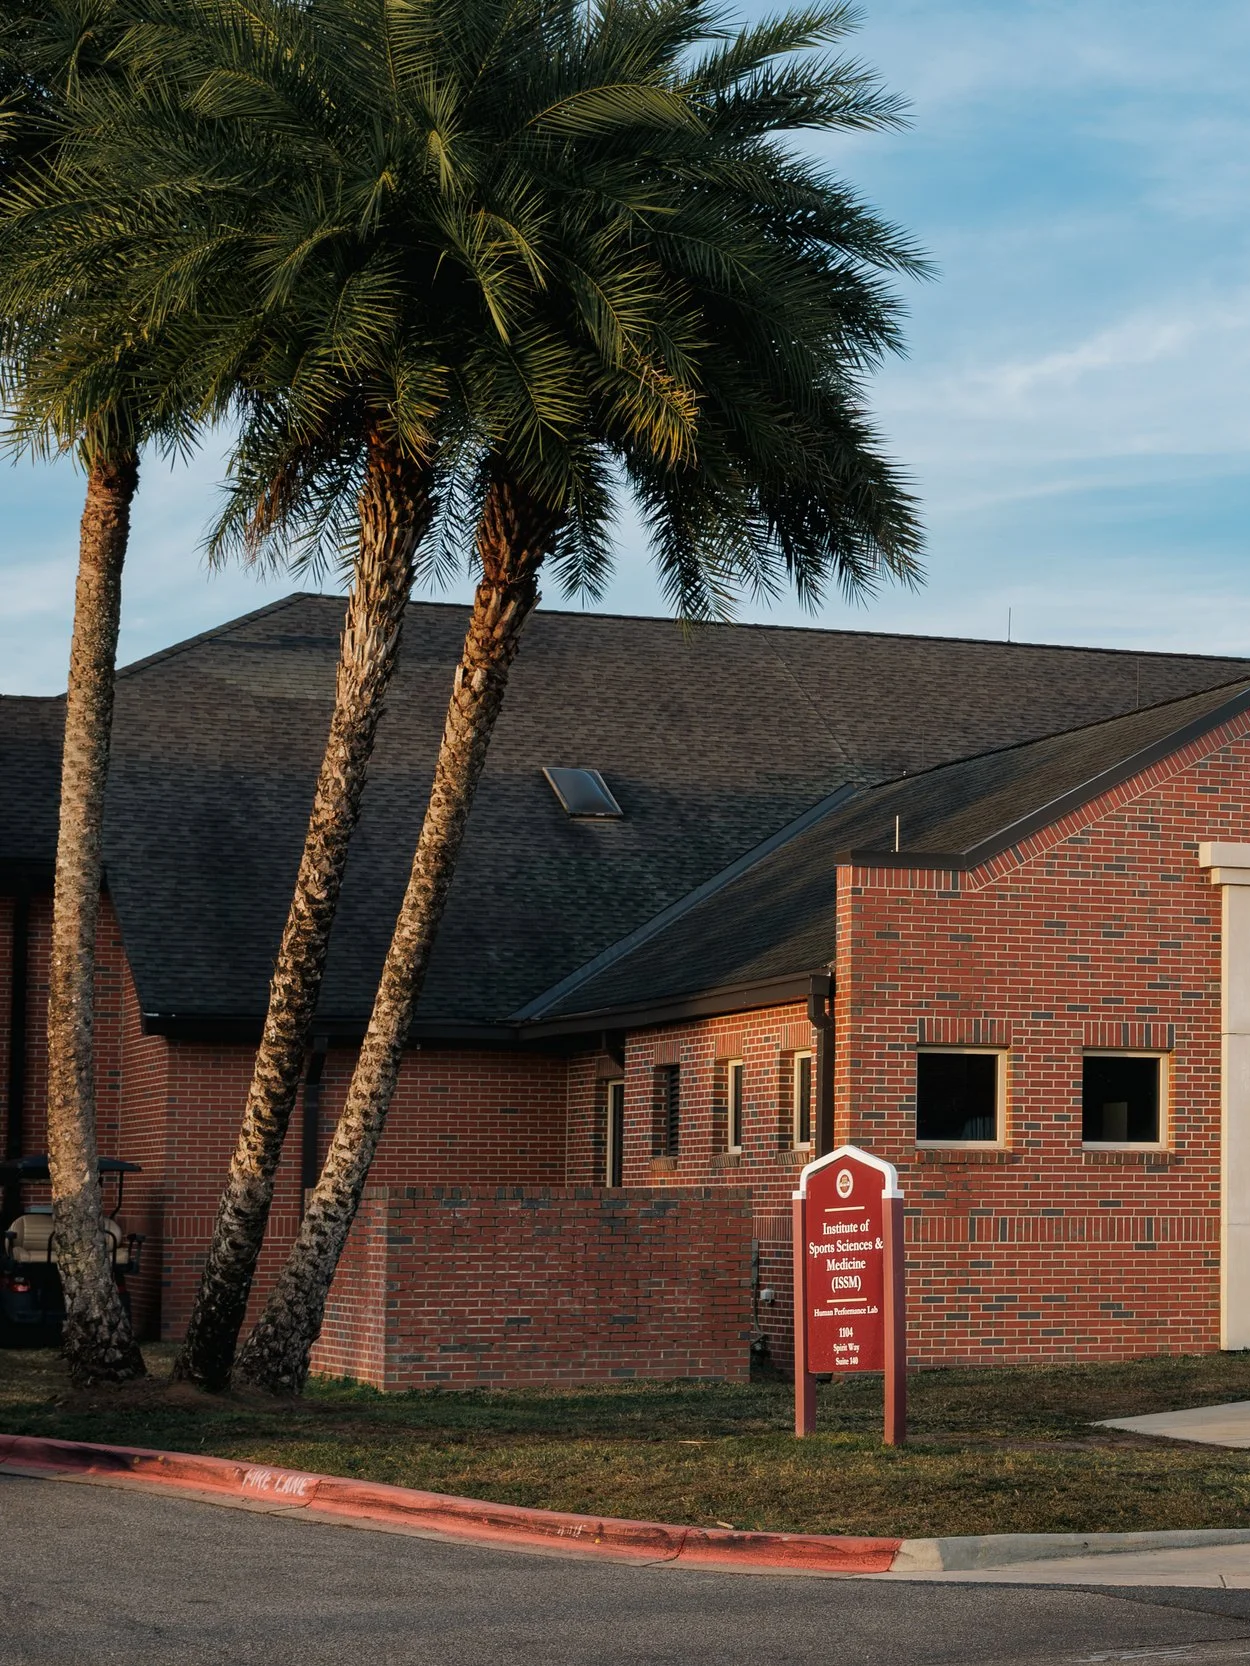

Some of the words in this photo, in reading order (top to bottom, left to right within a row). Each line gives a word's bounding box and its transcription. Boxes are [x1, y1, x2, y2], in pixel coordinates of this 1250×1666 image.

[822, 1221, 858, 1235] Institute
[860, 1218, 870, 1232] of
[809, 1242, 835, 1258] Sports
[836, 1239, 873, 1253] Sciences
[874, 1237, 884, 1250] &
[826, 1257, 866, 1271] Medicine
[831, 1275, 862, 1293] (ISSM)
[813, 1308, 833, 1317] Human
[834, 1306, 867, 1316] Performance
[866, 1305, 879, 1314] Lab
[838, 1326, 853, 1338] 1104
[833, 1343, 848, 1354] Spirit
[847, 1342, 860, 1353] Way
[835, 1357, 849, 1366] Suite
[241, 1468, 272, 1492] FIRE
[274, 1473, 313, 1497] LANE
